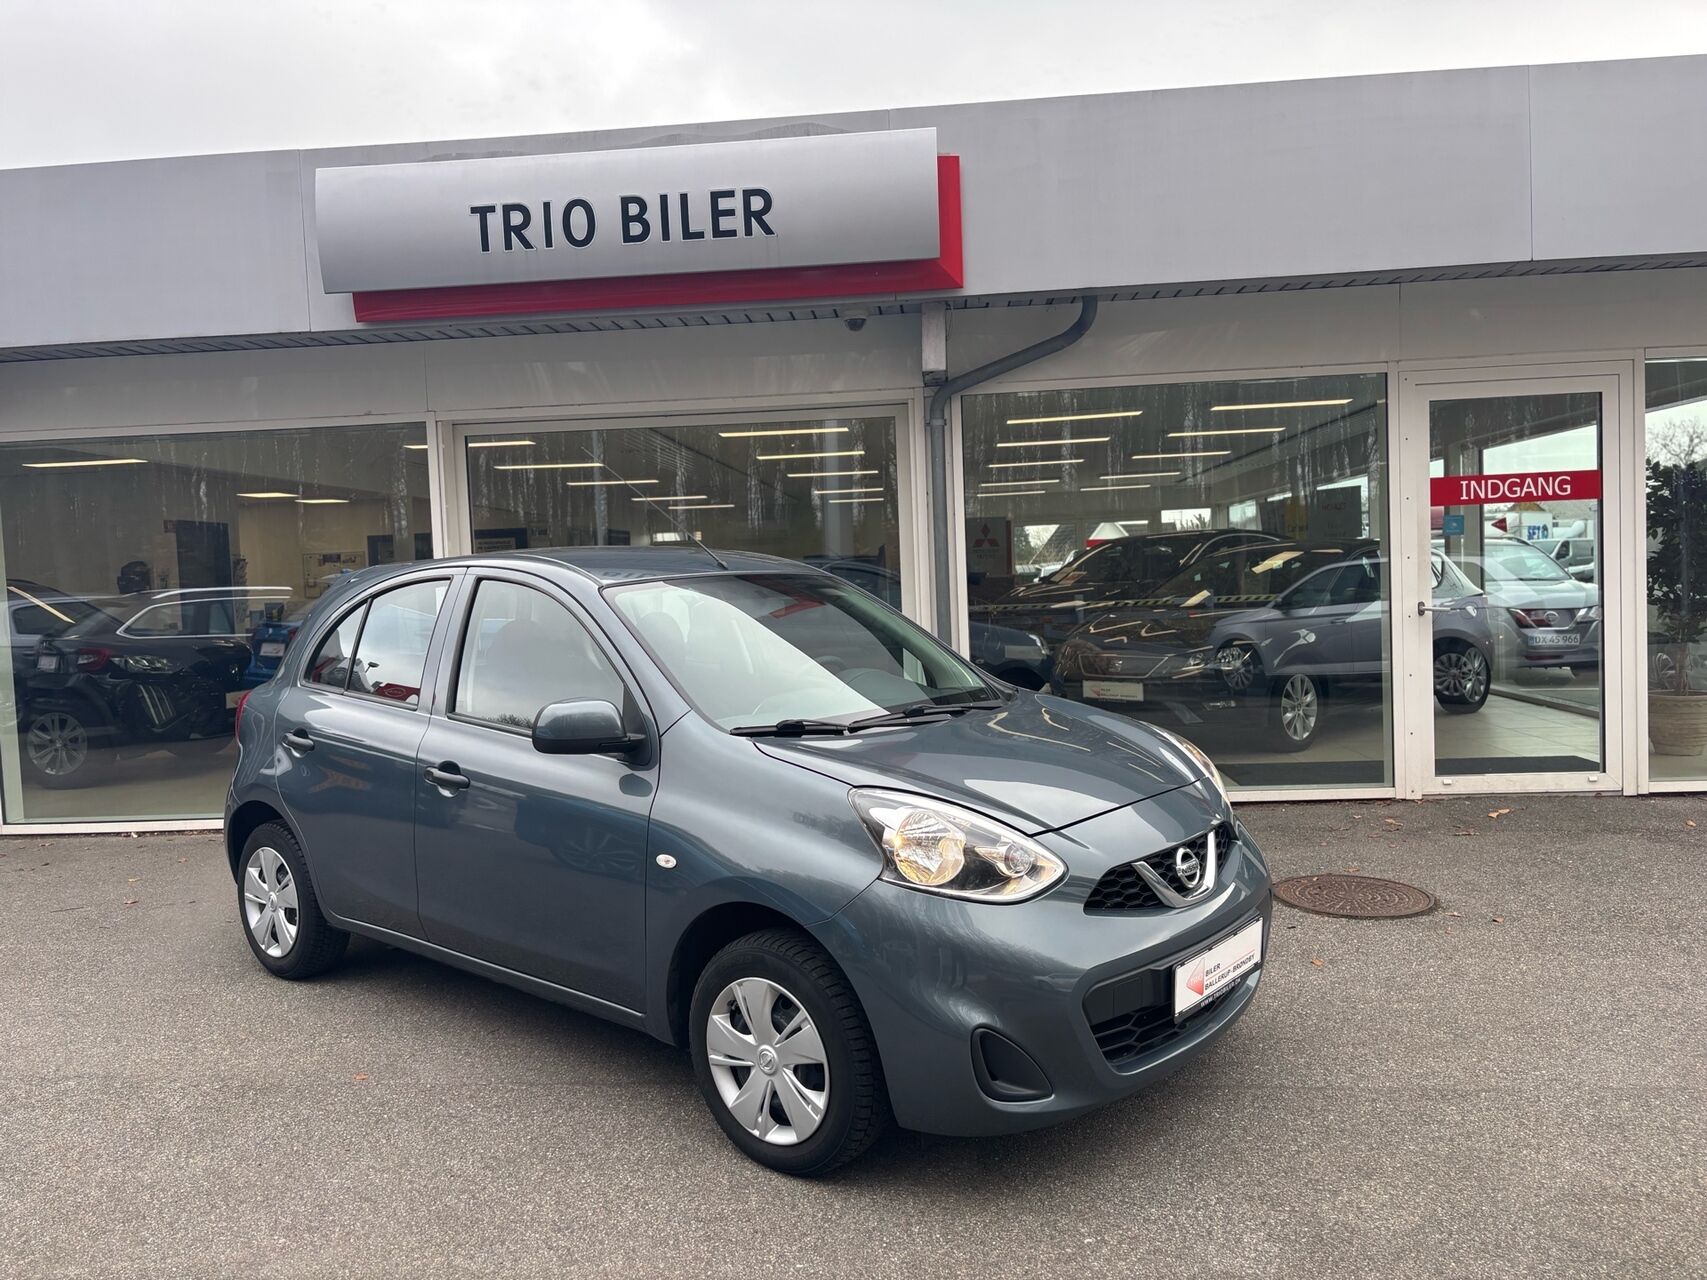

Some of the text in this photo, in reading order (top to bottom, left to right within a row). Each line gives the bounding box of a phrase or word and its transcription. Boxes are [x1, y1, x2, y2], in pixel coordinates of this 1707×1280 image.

[470, 187, 776, 253] TRIO BILER
[1459, 476, 1572, 500] INDGANG
[1205, 963, 1221, 977] BILER
